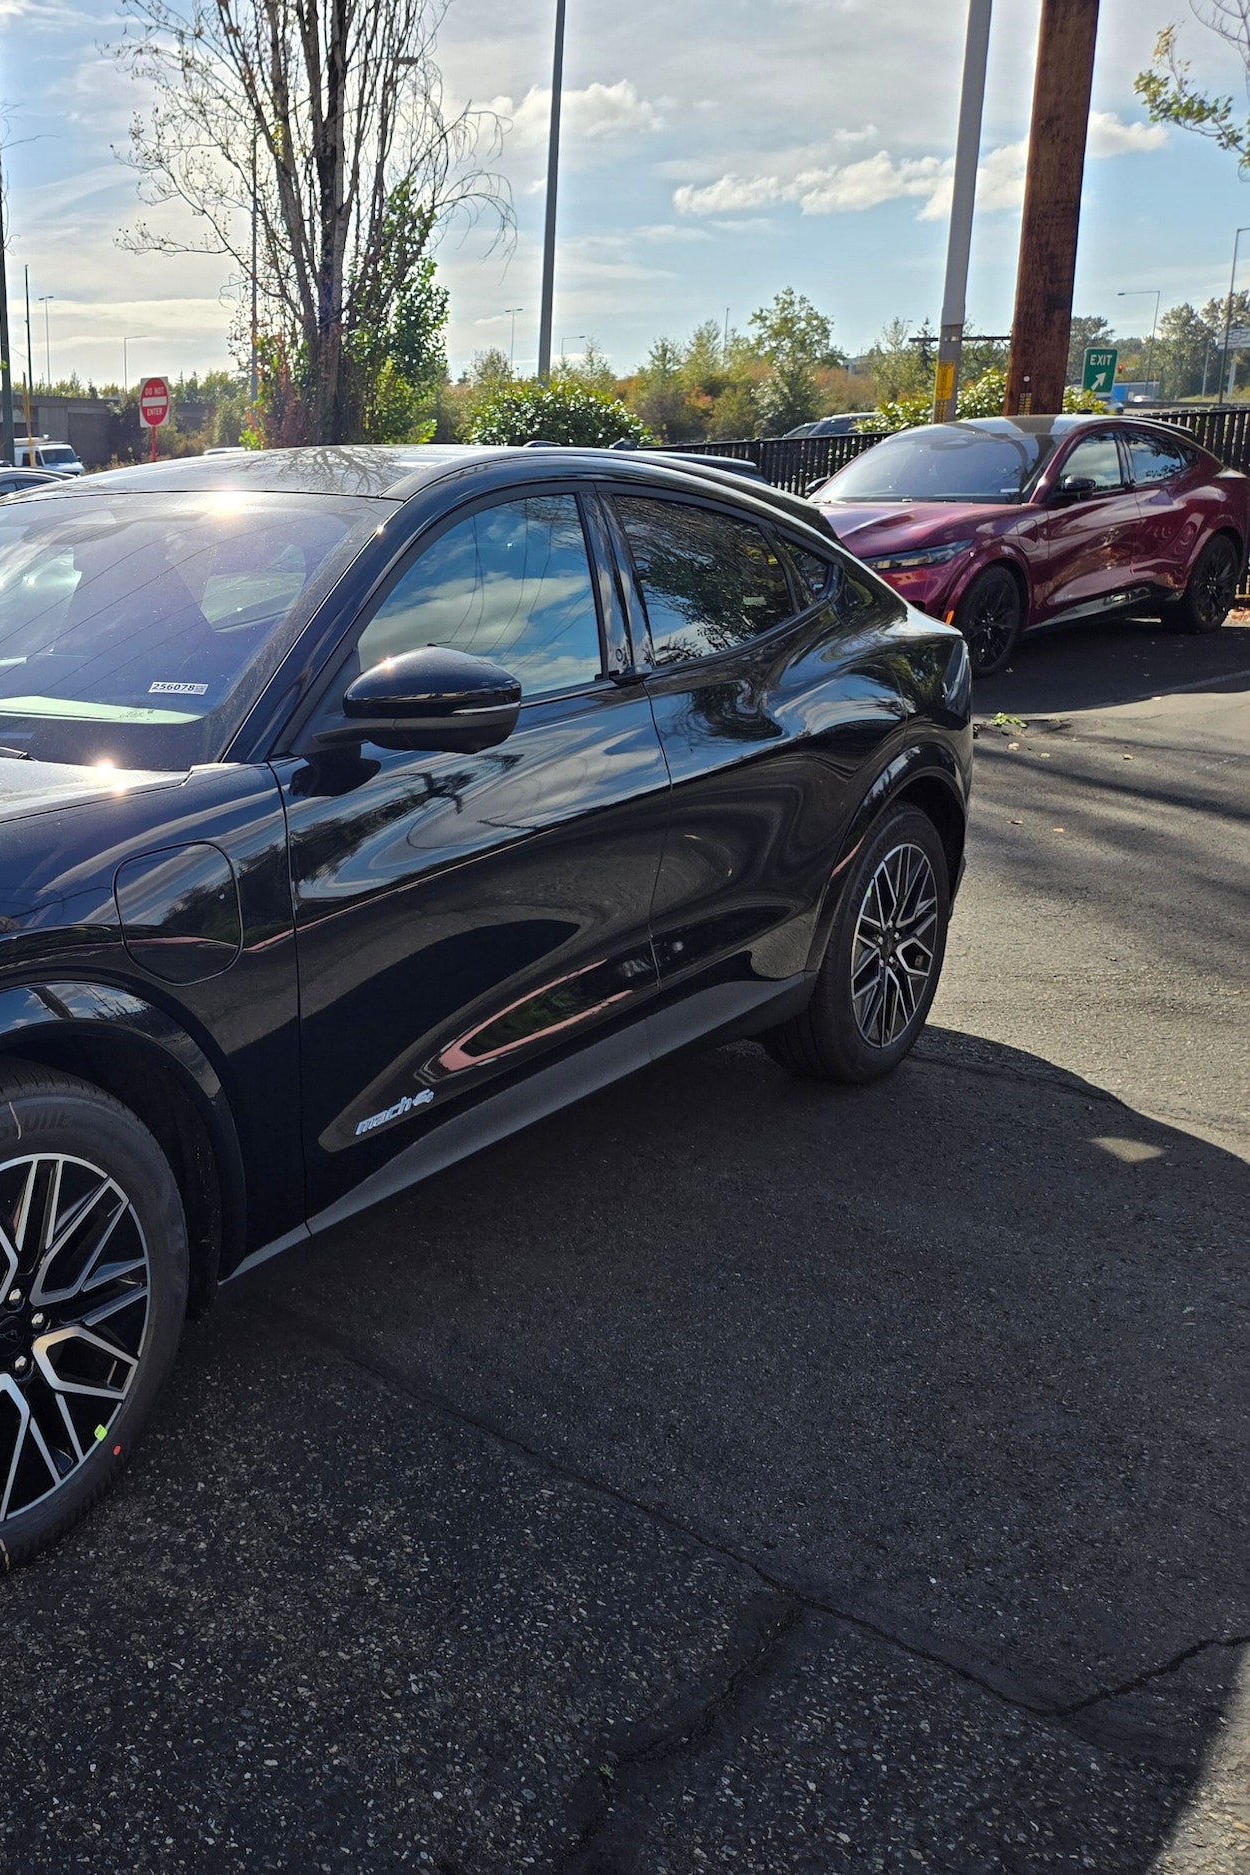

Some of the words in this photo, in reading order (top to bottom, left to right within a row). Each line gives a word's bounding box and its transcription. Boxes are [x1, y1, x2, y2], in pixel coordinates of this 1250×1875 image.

[1089, 353, 1113, 366] EXIT
[144, 387, 153, 396] DO
[153, 386, 165, 395] NOT
[146, 407, 163, 417] ENTER
[151, 683, 196, 692] 256078
